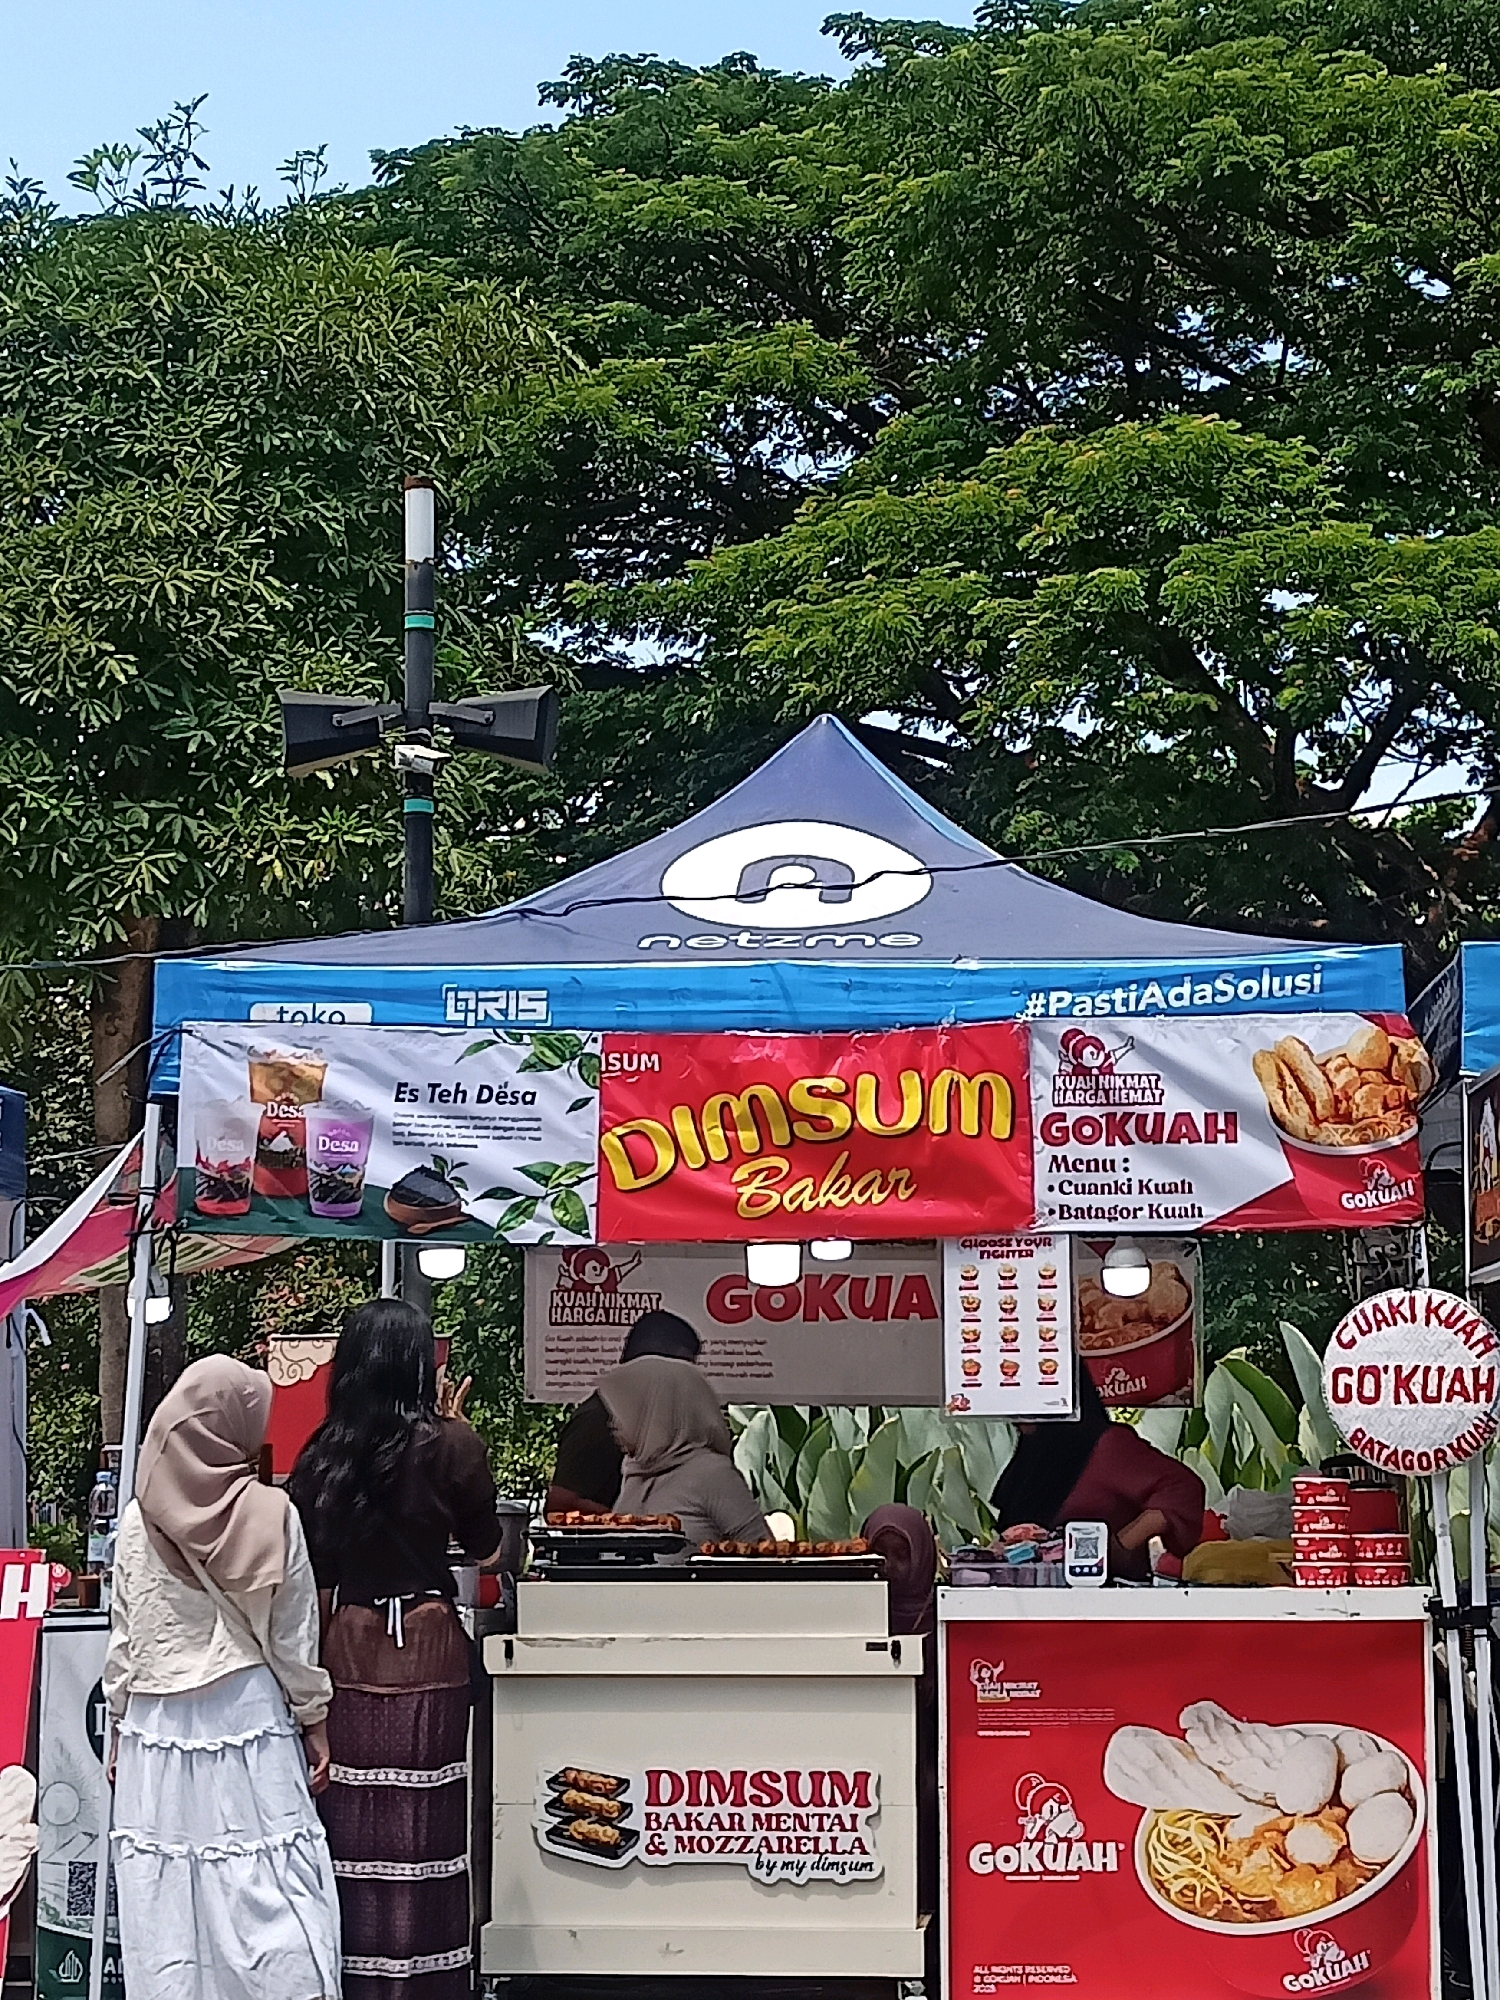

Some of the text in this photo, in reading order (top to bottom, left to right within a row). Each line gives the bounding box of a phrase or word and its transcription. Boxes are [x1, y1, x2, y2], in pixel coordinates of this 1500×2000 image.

[637, 931, 923, 950] netzme
[1025, 963, 1324, 1017] #PastiAdaSolusi
[443, 985, 551, 1028] QRIS
[393, 1081, 420, 1103] Es
[427, 1081, 468, 1104] Teh
[1055, 1075, 1158, 1090] KUAH NIKMAT
[1054, 1088, 1163, 1105] HARGA HEMAT
[600, 1068, 1013, 1191] DIMSUM
[1048, 1154, 1117, 1173] Menu
[731, 1150, 918, 1219] Bakar
[1058, 1178, 1194, 1196] Cuanki Kuah
[1058, 1203, 1204, 1223] Batagor Kuah
[1015, 1236, 1053, 1248] YOUR
[552, 1290, 660, 1311] KUAH NIKMAT
[706, 1273, 939, 1324] GOKUA
[551, 1306, 645, 1325] HARGA HEM
[1335, 1293, 1500, 1360] CUAKI KUAH
[1331, 1364, 1496, 1406] GO'KUAH
[1348, 1410, 1499, 1472] BATAGOR KUAH
[644, 1769, 872, 1808] DIMSUM
[644, 1812, 859, 1833] BAKAR MENTAI
[644, 1832, 871, 1856] & MOZZARELLA
[755, 1852, 875, 1877] by my dimsum
